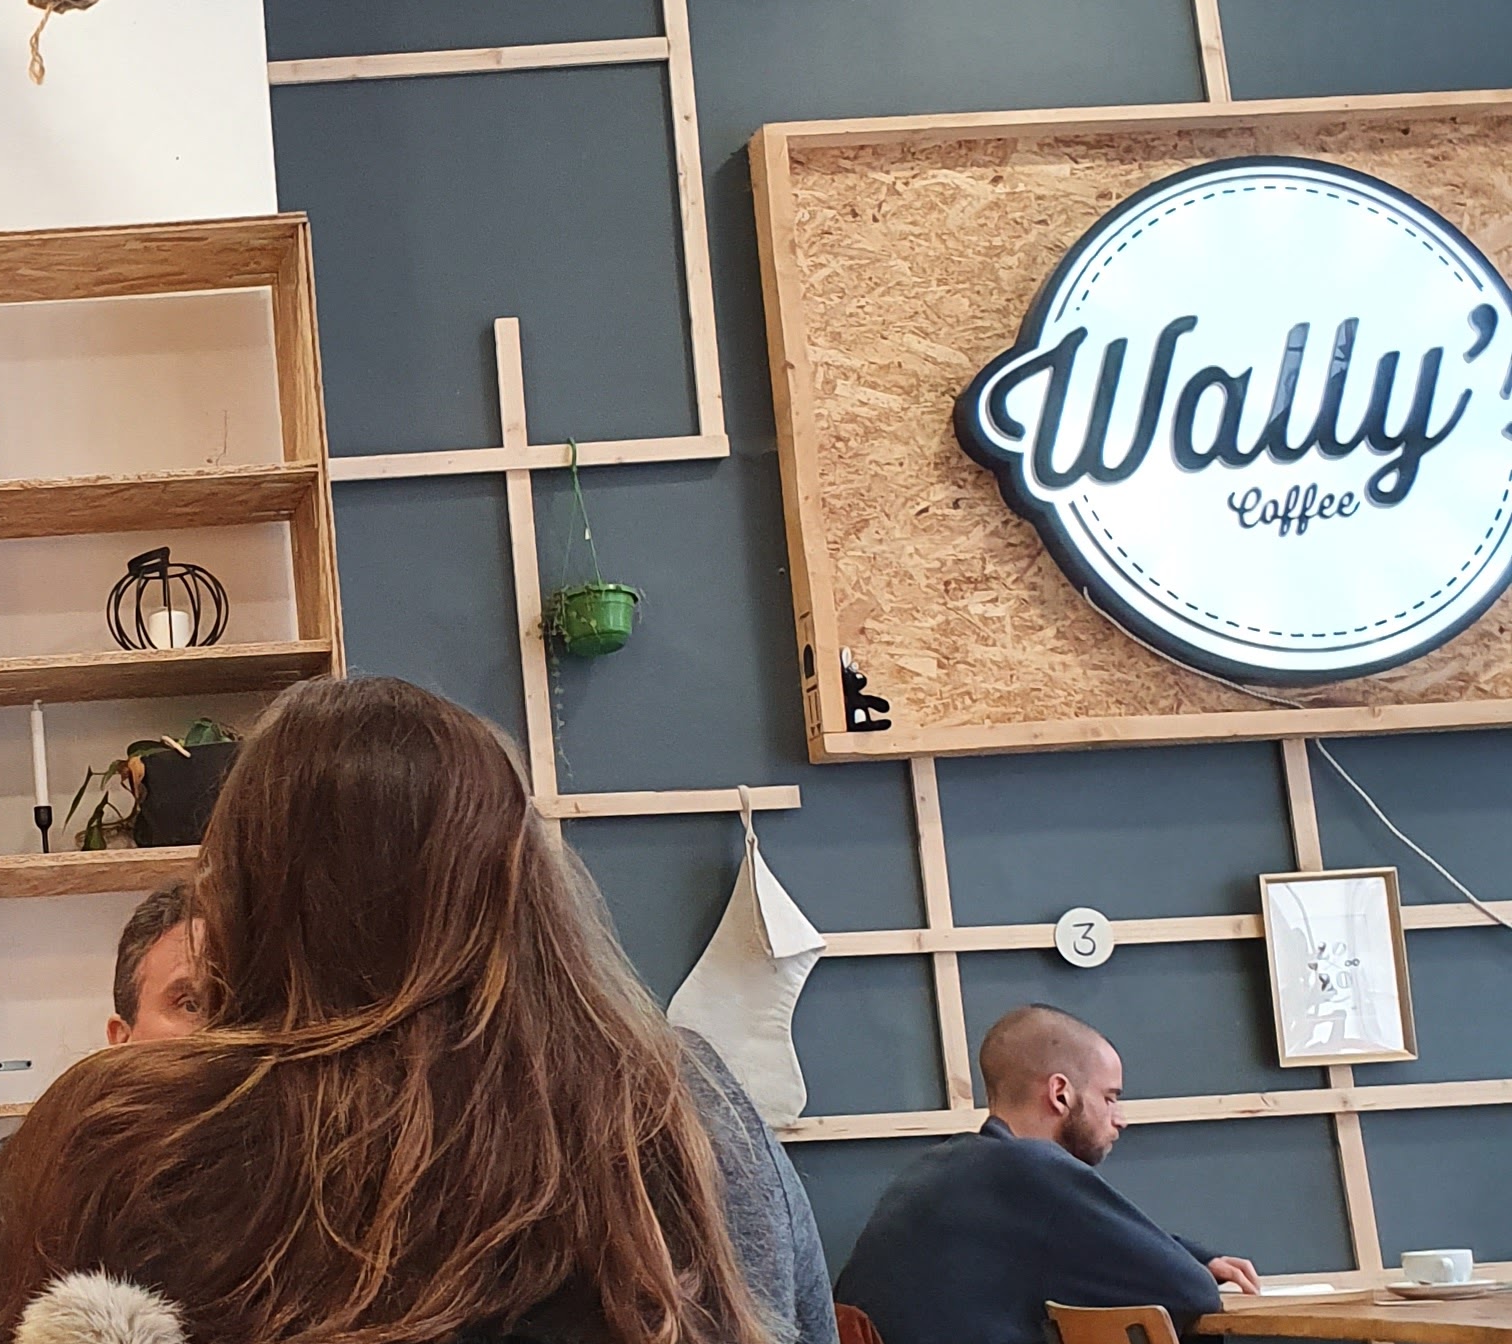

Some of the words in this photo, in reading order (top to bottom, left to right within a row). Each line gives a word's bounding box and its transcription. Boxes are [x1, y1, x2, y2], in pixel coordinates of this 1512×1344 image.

[987, 303, 1512, 507] Wally'
[1227, 482, 1360, 537] Coffee
[1073, 922, 1097, 957] 3
